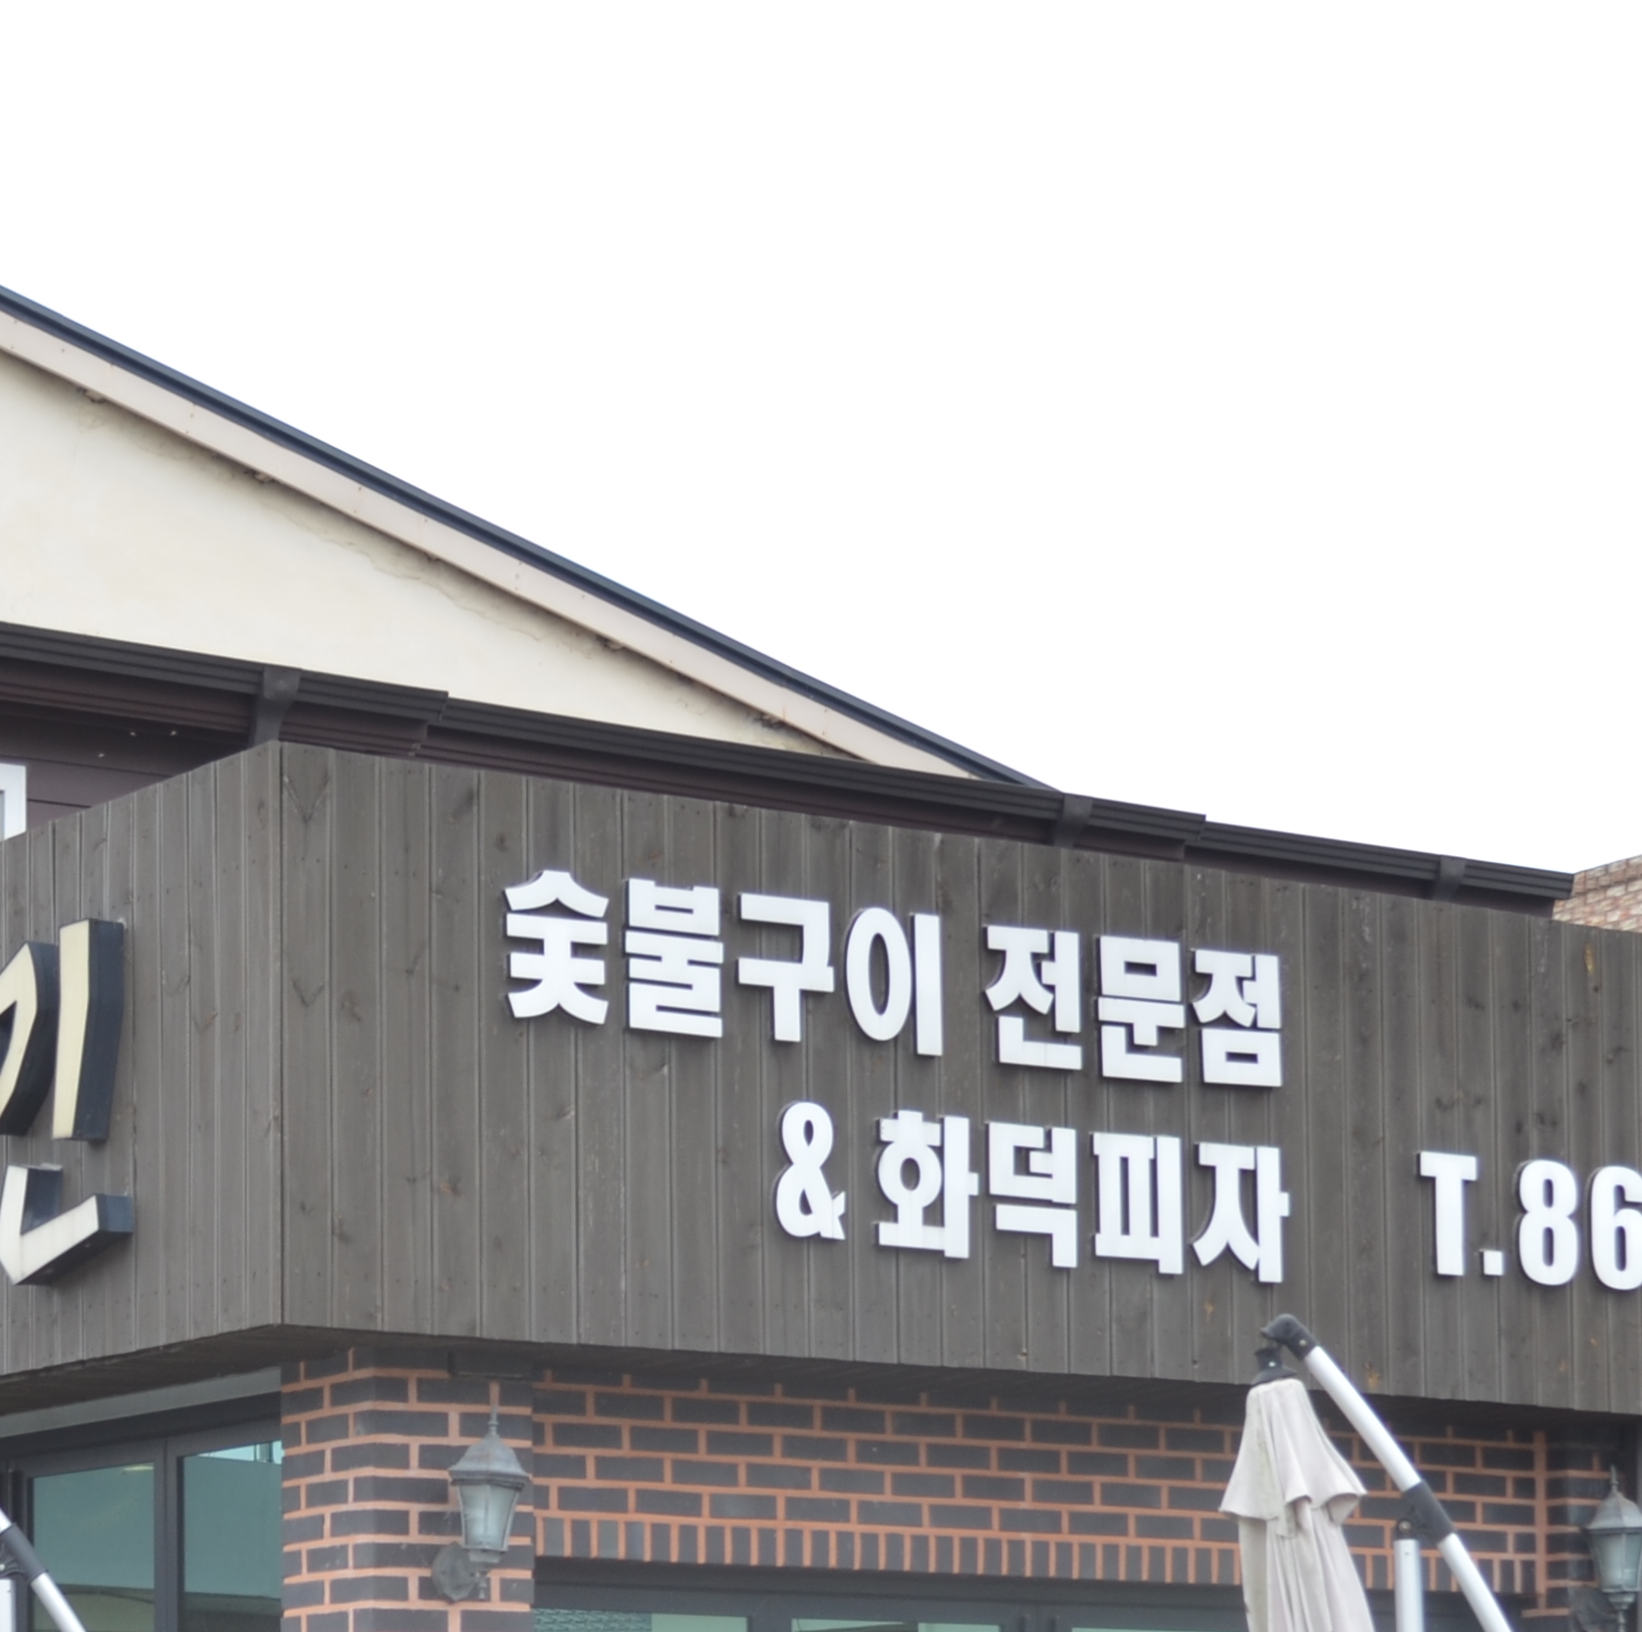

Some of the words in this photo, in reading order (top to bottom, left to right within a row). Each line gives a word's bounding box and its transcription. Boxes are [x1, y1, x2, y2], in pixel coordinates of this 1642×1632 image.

[505, 870, 942, 1057] 숯불구이
[986, 925, 1283, 1087] 전문점
[776, 1101, 845, 1240] &
[876, 1111, 1290, 1284] 화덕피자
